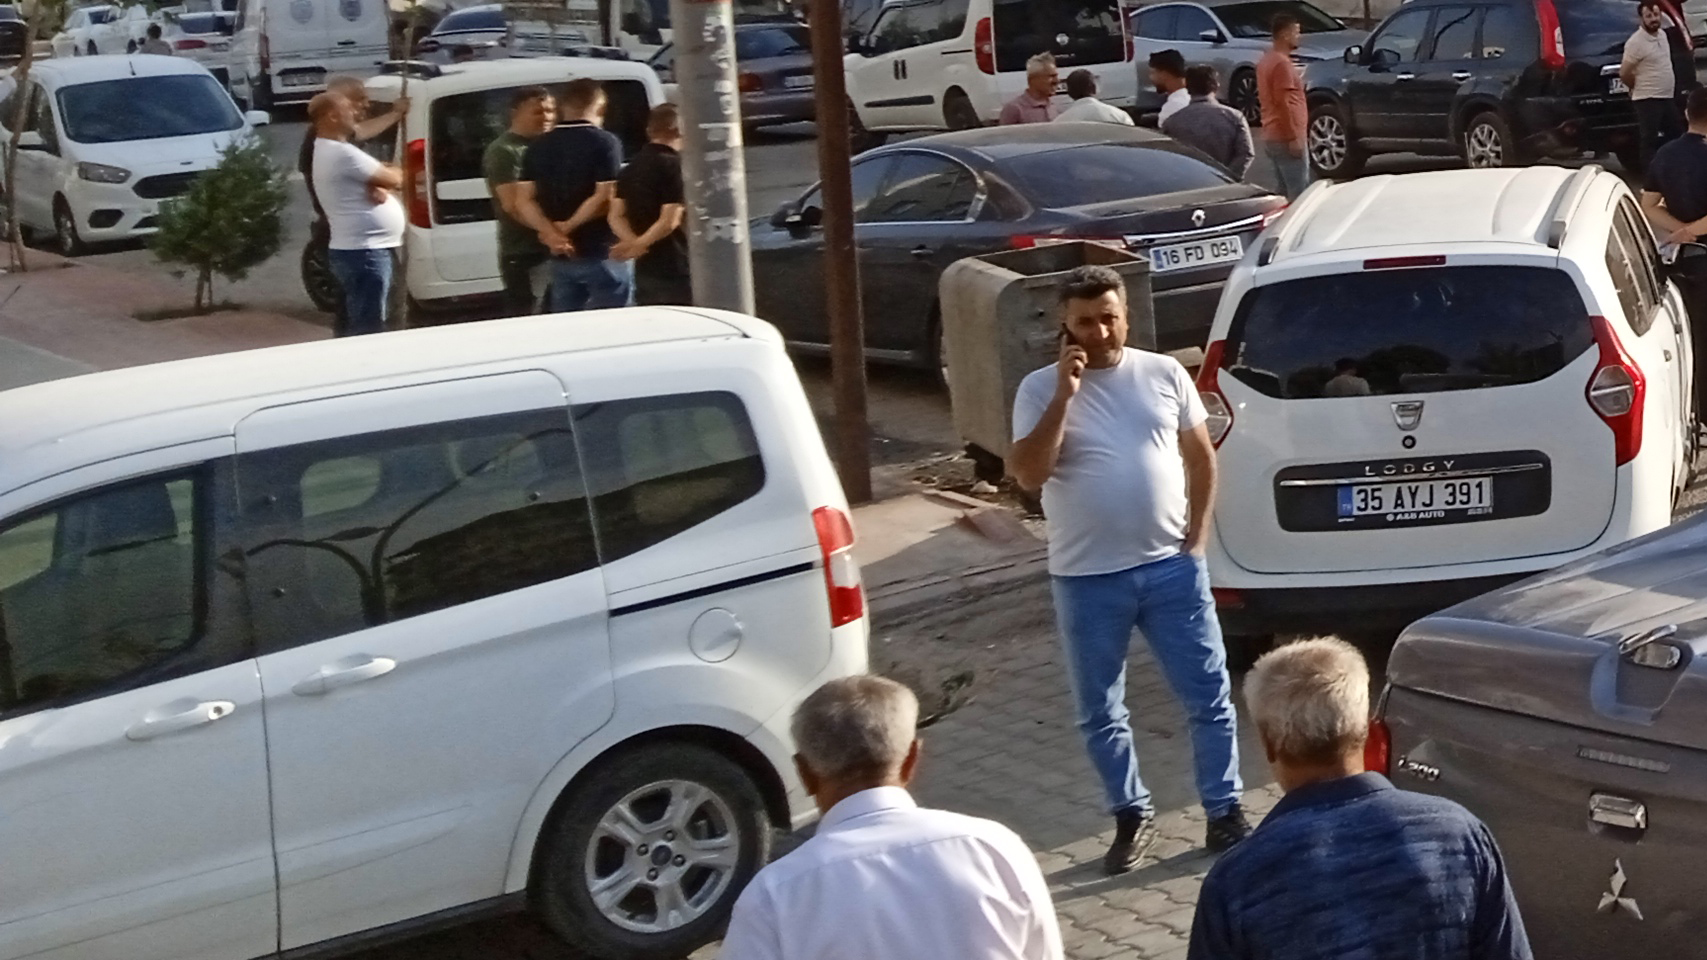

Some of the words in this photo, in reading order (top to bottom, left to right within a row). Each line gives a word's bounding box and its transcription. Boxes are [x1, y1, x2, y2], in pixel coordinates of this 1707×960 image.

[1162, 249, 1180, 266] 16
[1184, 245, 1205, 262] FD
[1364, 460, 1455, 476] LODGY
[1356, 487, 1383, 512] 35
[1393, 484, 1434, 510] AYJ
[1444, 480, 1483, 506] 391
[1418, 510, 1445, 519] AUTO
